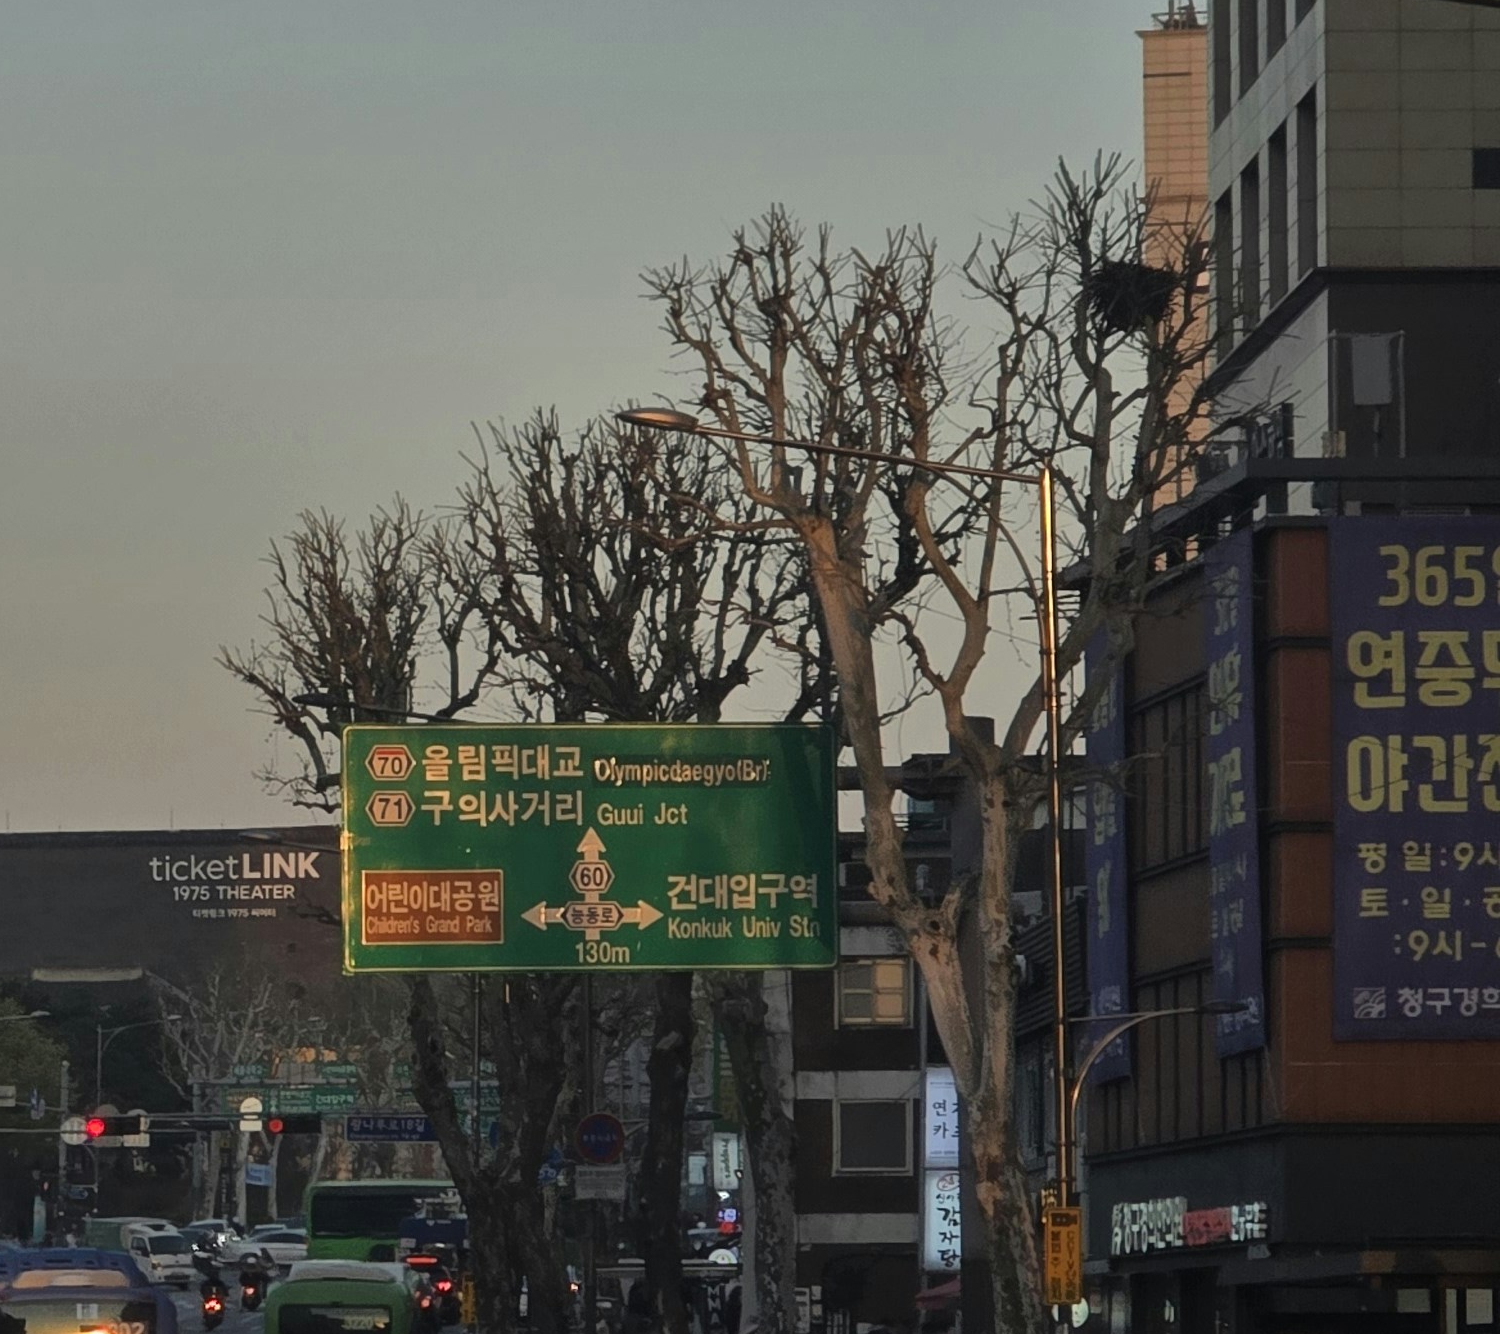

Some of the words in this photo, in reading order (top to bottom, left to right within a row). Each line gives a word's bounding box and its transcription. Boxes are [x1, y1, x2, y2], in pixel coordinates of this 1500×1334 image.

[1378, 544, 1500, 606] 365
[377, 755, 406, 777] 70
[422, 744, 584, 782] 올림픽대교
[378, 797, 405, 821] 71
[421, 790, 584, 828] 구의사거리
[597, 802, 645, 826] Guui
[655, 802, 688, 825] Jct
[148, 851, 321, 882] ticketLINK
[579, 866, 604, 888] 60
[173, 886, 210, 901] 1975
[216, 884, 296, 900] THEATER
[366, 879, 502, 913] 어린이대공원
[667, 873, 820, 911] 건대입구역
[227, 908, 249, 918] 1975
[571, 906, 615, 926] 능동로
[366, 916, 421, 935] Children's
[425, 916, 462, 935] Grand
[465, 916, 493, 934] Park
[668, 919, 732, 940] Konkuk
[742, 918, 782, 938] Univ
[789, 918, 821, 938] Stn
[575, 942, 631, 964] 130m
